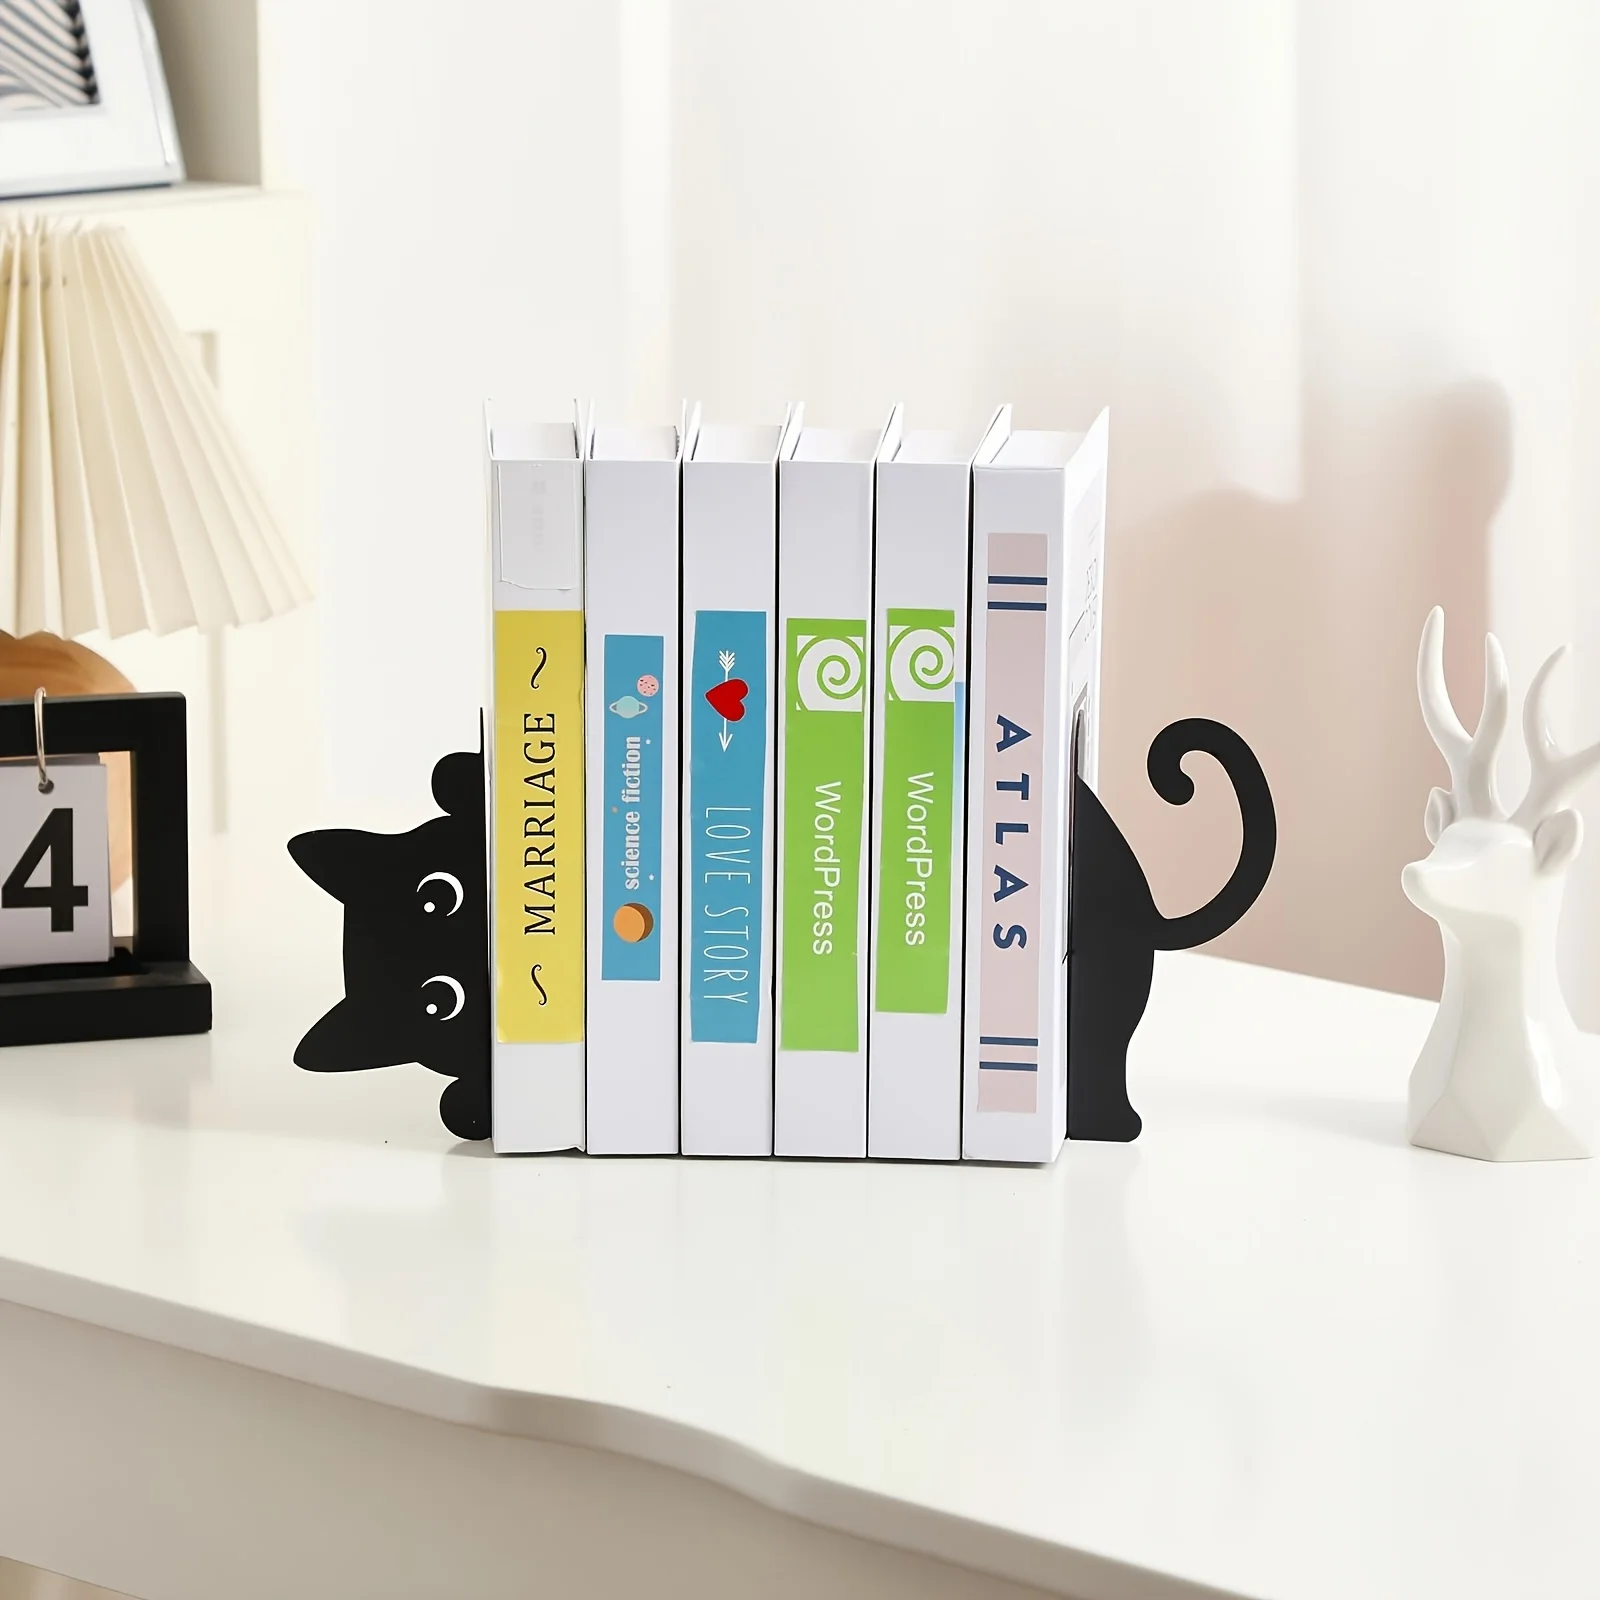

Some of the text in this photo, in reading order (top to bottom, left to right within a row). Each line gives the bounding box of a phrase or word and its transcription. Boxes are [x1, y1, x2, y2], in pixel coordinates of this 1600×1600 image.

[1, 807, 89, 933] 4
[523, 713, 556, 936] MARRIAGE
[620, 736, 642, 890] science fiction
[812, 781, 842, 956] WordPress
[905, 771, 935, 946] WordPress
[992, 714, 1032, 950] ATLAS
[703, 806, 752, 1004] LOVE STORY
